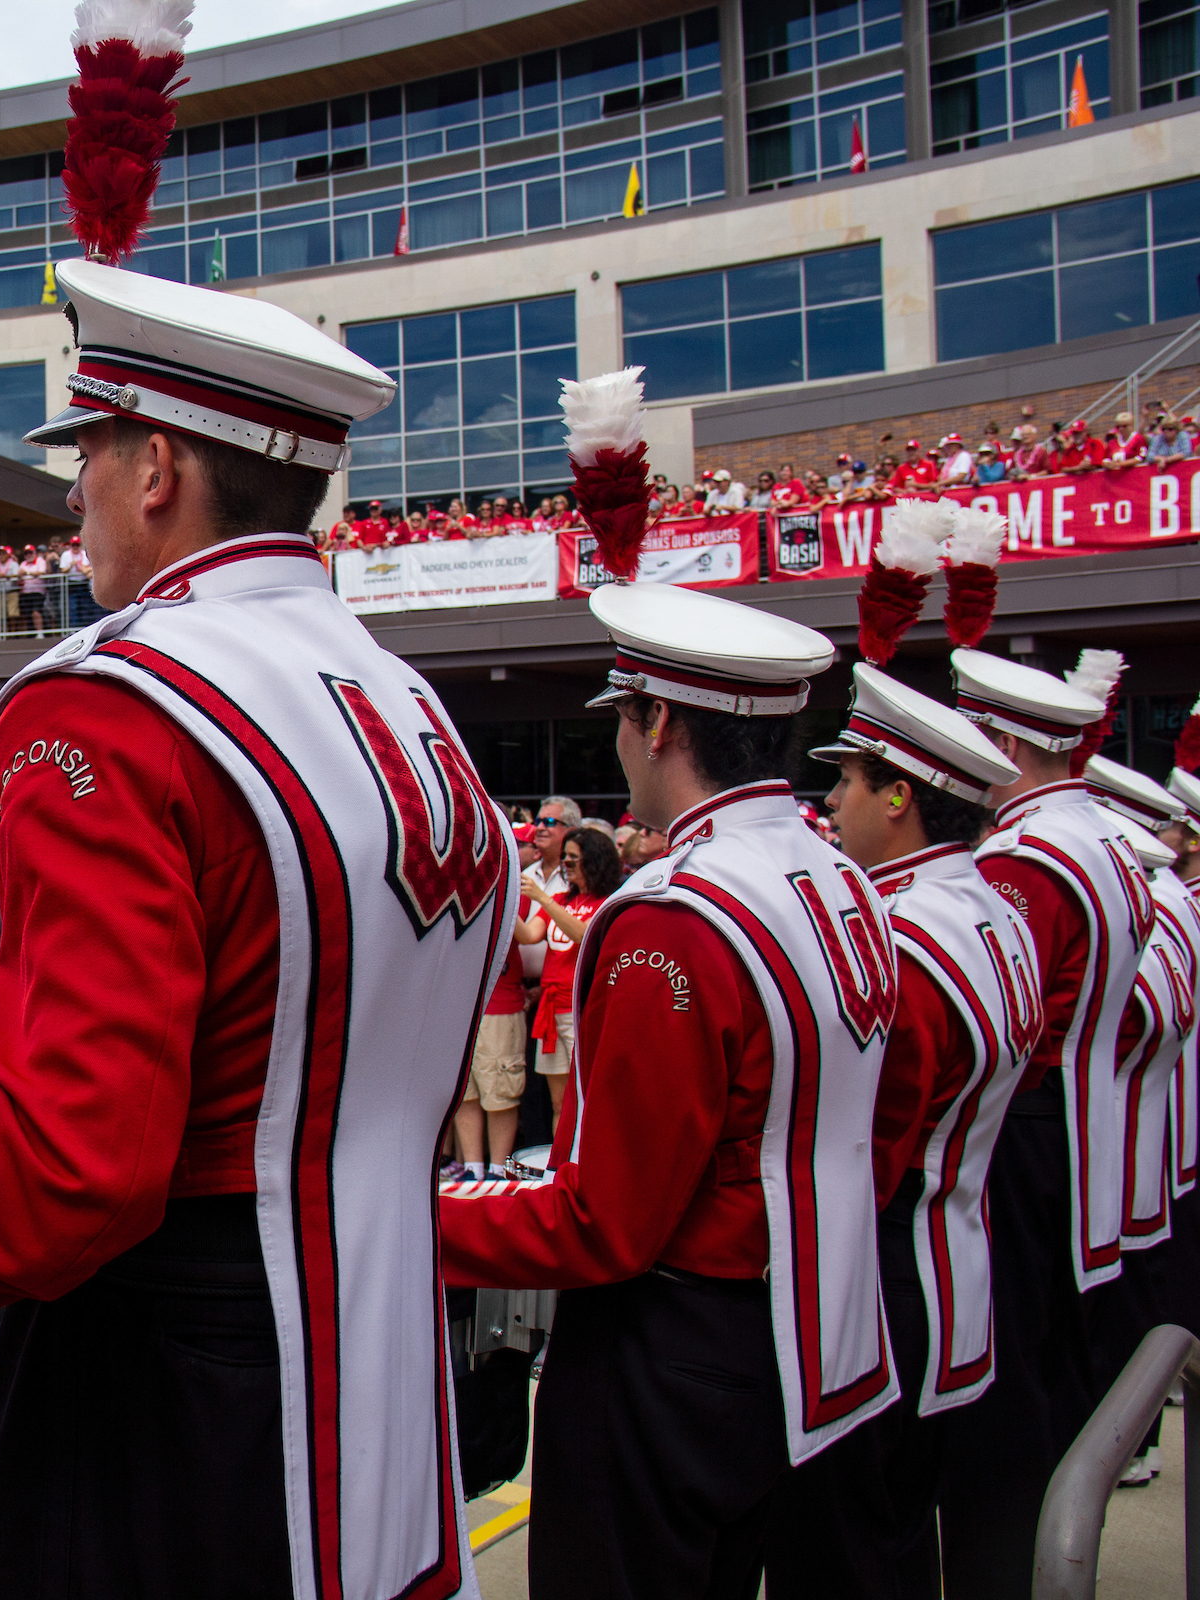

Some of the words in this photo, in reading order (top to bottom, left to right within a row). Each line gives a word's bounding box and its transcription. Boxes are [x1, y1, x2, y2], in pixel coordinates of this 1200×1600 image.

[781, 516, 817, 533] BADGER
[1091, 500, 1131, 526] TO
[1151, 474, 1200, 537] B
[672, 534, 691, 548] OUR
[693, 528, 740, 546] SPONSORS
[780, 542, 819, 564] BASH
[421, 562, 468, 573] BADGERLAND
[469, 559, 493, 569] CHEVY
[495, 557, 527, 567] DEALERS
[418, 588, 452, 597] UNIVERSITY
[465, 585, 496, 594] WISCONSIN
[498, 583, 528, 592] MARCHING
[0, 740, 97, 802] CONSIN
[318, 672, 504, 941] W
[990, 882, 1029, 920] CONSIN
[785, 862, 897, 1053] W
[607, 949, 691, 1012] WISCONSIN
